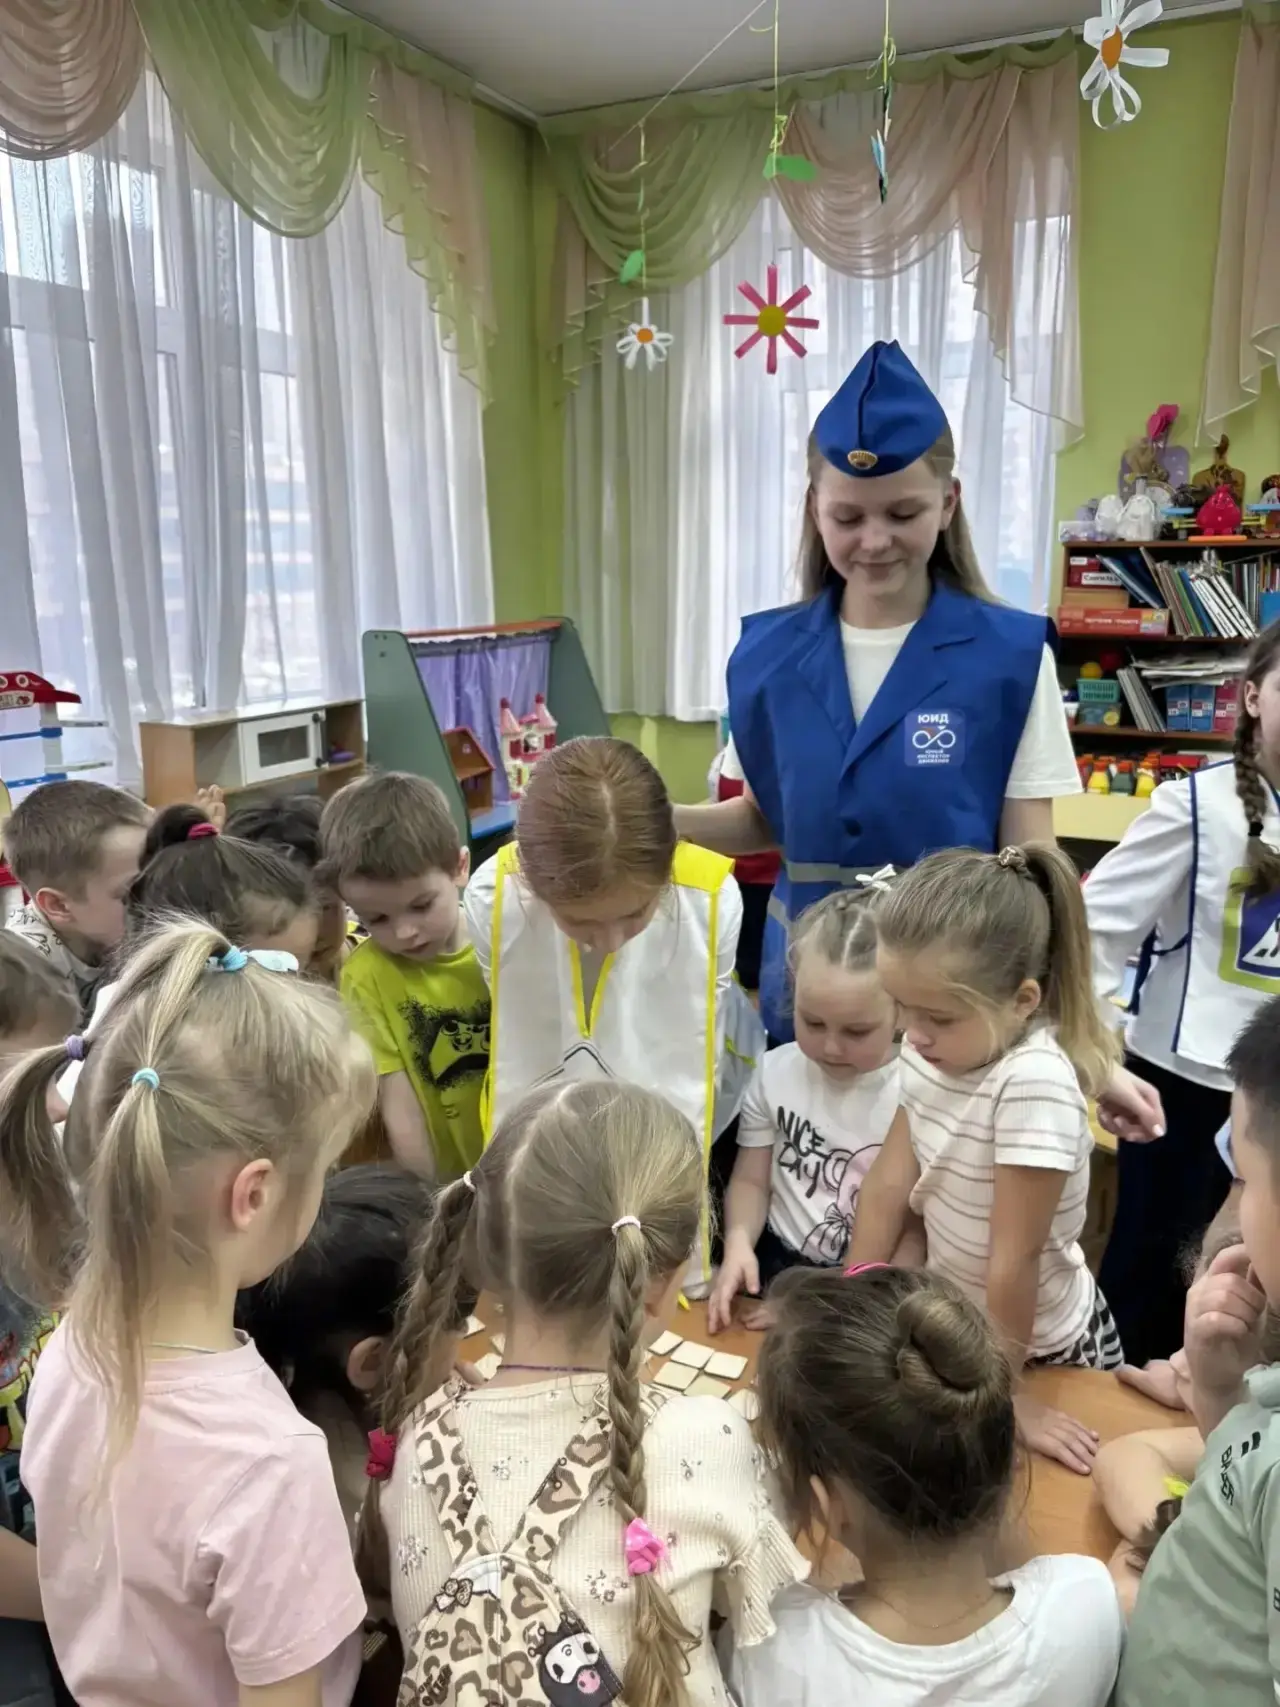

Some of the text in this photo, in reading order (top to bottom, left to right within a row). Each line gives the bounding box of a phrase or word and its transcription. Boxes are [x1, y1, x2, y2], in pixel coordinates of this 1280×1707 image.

[917, 713, 949, 724] ЮИД
[777, 1105, 831, 1160] NICE
[777, 1141, 820, 1199] DAY
